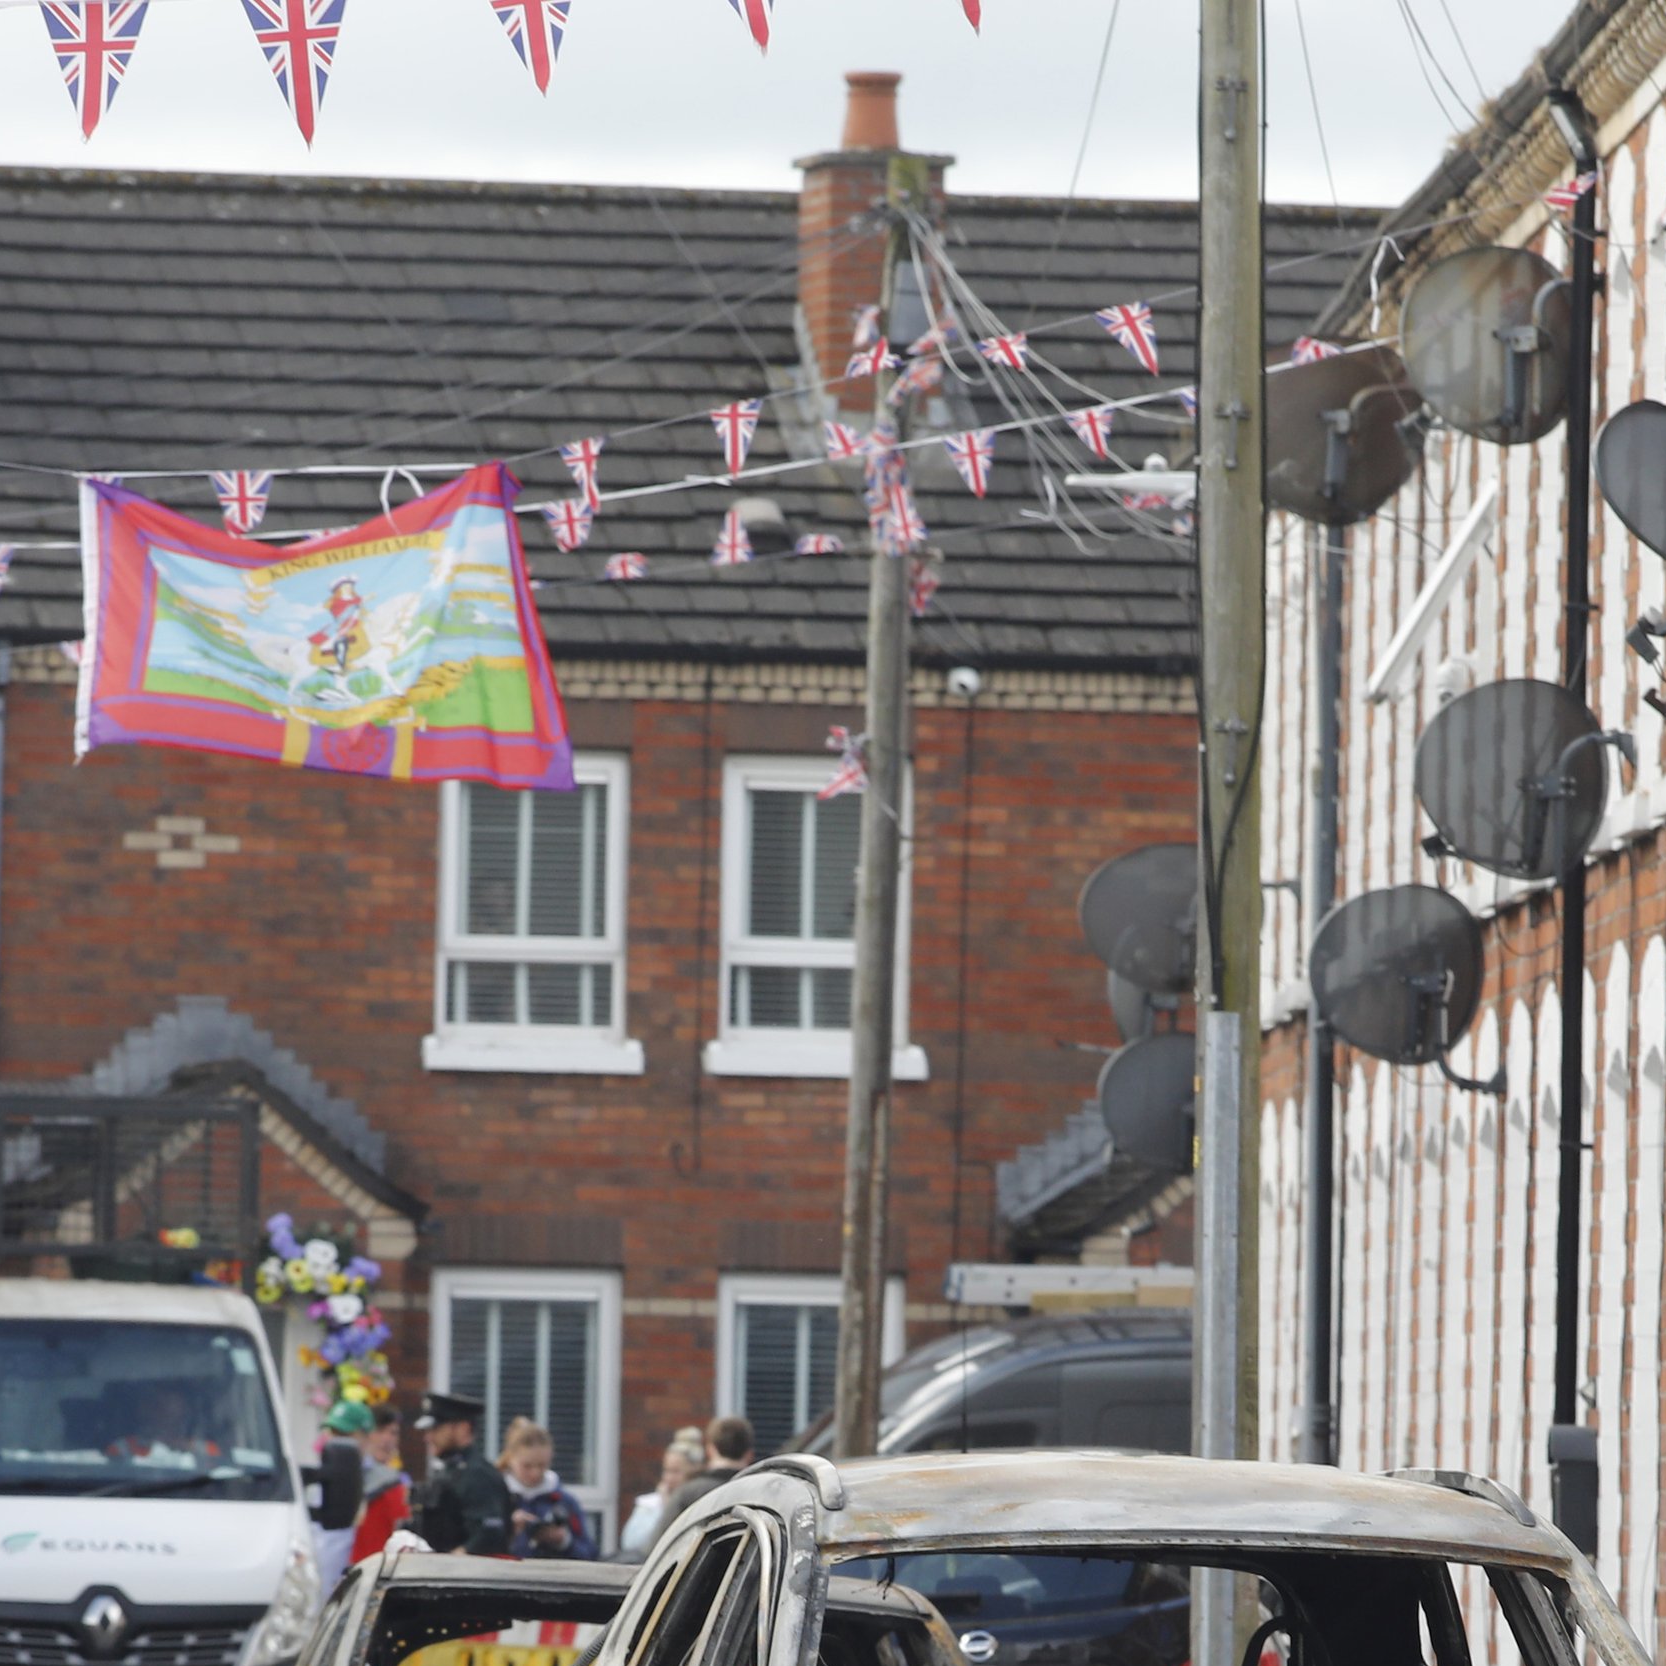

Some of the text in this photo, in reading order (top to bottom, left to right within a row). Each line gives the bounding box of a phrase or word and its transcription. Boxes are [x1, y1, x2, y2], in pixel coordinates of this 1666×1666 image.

[268, 555, 319, 580] KING
[324, 537, 410, 564] WILLIAM
[39, 1538, 178, 1555] EQUANS
